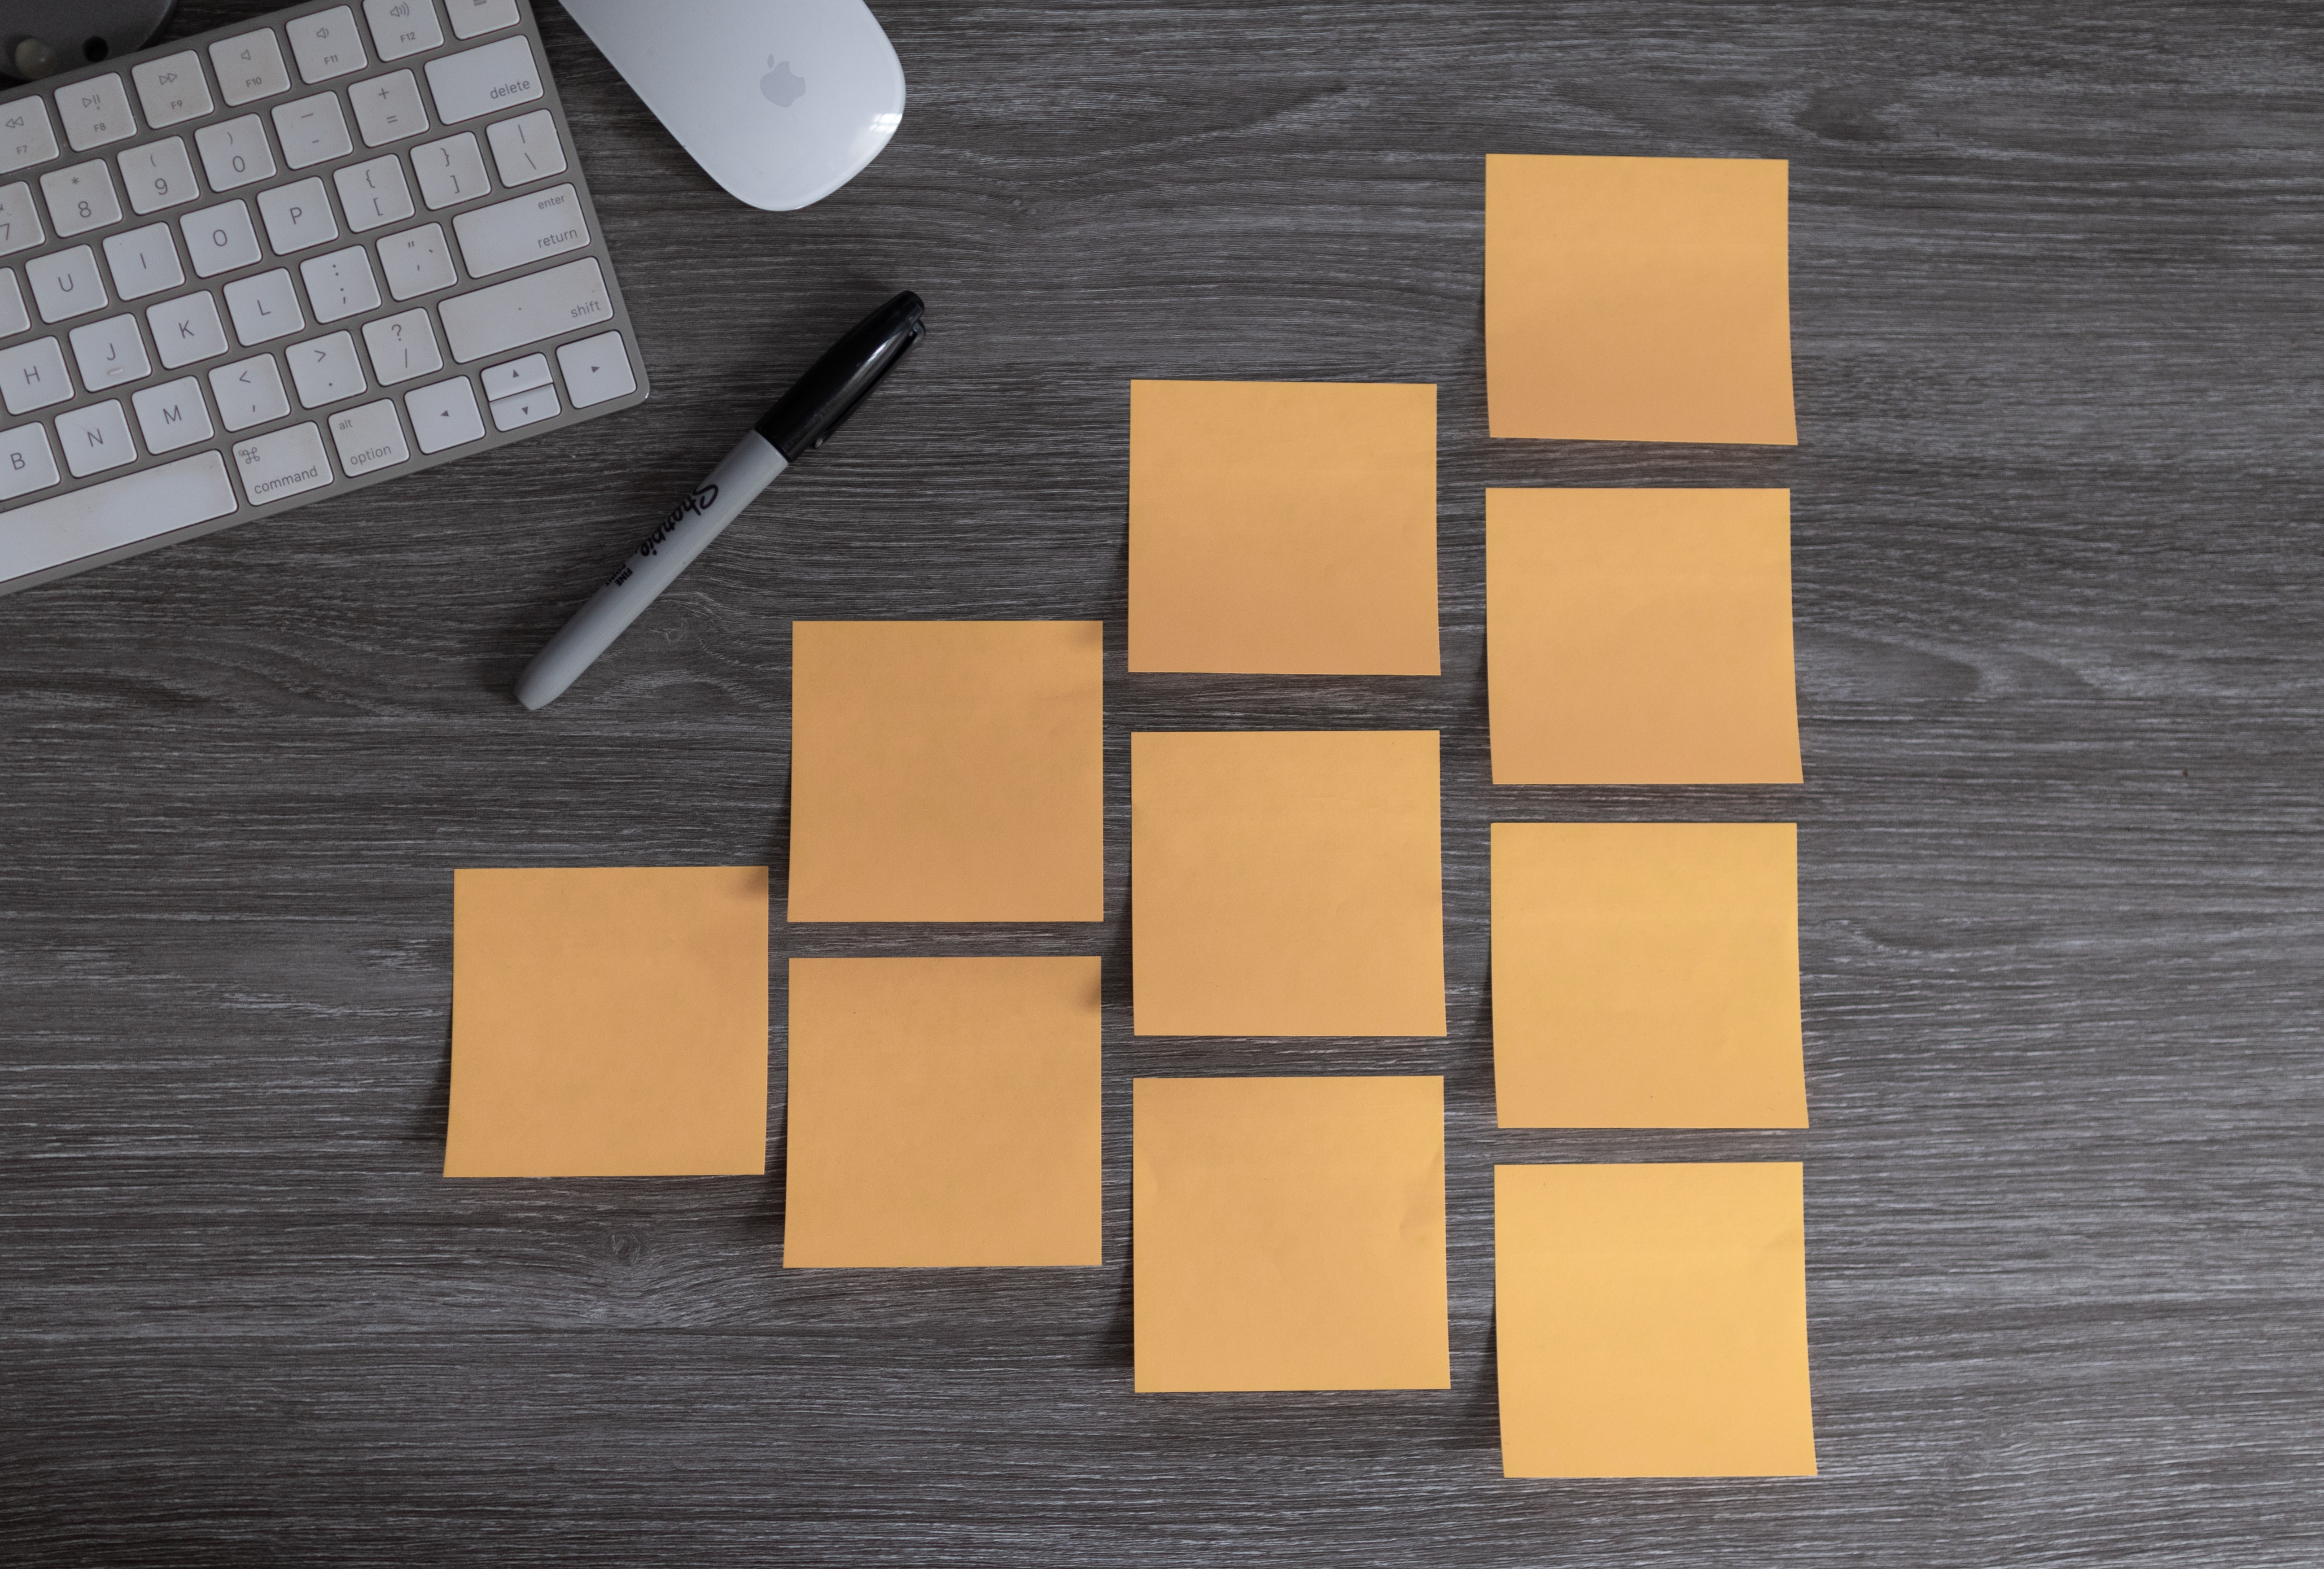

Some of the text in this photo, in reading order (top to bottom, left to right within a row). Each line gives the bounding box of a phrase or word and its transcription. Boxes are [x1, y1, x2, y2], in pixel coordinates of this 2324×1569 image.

[400, 32, 416, 43] F12
[324, 55, 338, 65] F11
[245, 77, 262, 87] F10
[490, 80, 530, 99] delete
[378, 88, 389, 99] +
[171, 100, 183, 109] F9
[94, 122, 106, 132] F8
[386, 115, 398, 124] =
[227, 132, 233, 145] )
[16, 144, 27, 155] F7
[440, 148, 450, 167] }
[150, 154, 156, 167] (
[232, 155, 245, 173] 0
[524, 153, 537, 170] \
[154, 178, 168, 195] 9
[366, 169, 376, 188] {
[450, 175, 460, 194] ]
[78, 201, 92, 218] 8
[373, 197, 383, 216] [
[538, 195, 565, 209] enter
[289, 207, 302, 225] P
[213, 229, 228, 247] O
[538, 229, 578, 248] return
[333, 264, 339, 276] :
[57, 274, 74, 292] U
[340, 288, 346, 304] ;
[257, 300, 271, 316] L
[570, 301, 601, 318] shift
[179, 320, 194, 339] K
[391, 323, 402, 341] ?
[107, 343, 116, 361] J
[314, 350, 326, 363] >
[23, 366, 40, 385] H
[239, 371, 251, 383] <
[163, 405, 182, 424] M
[339, 420, 353, 430] alt
[87, 428, 104, 447] N
[10, 452, 26, 470] B
[350, 446, 391, 465] option
[254, 468, 318, 494] command
[614, 568, 633, 586] FINE
